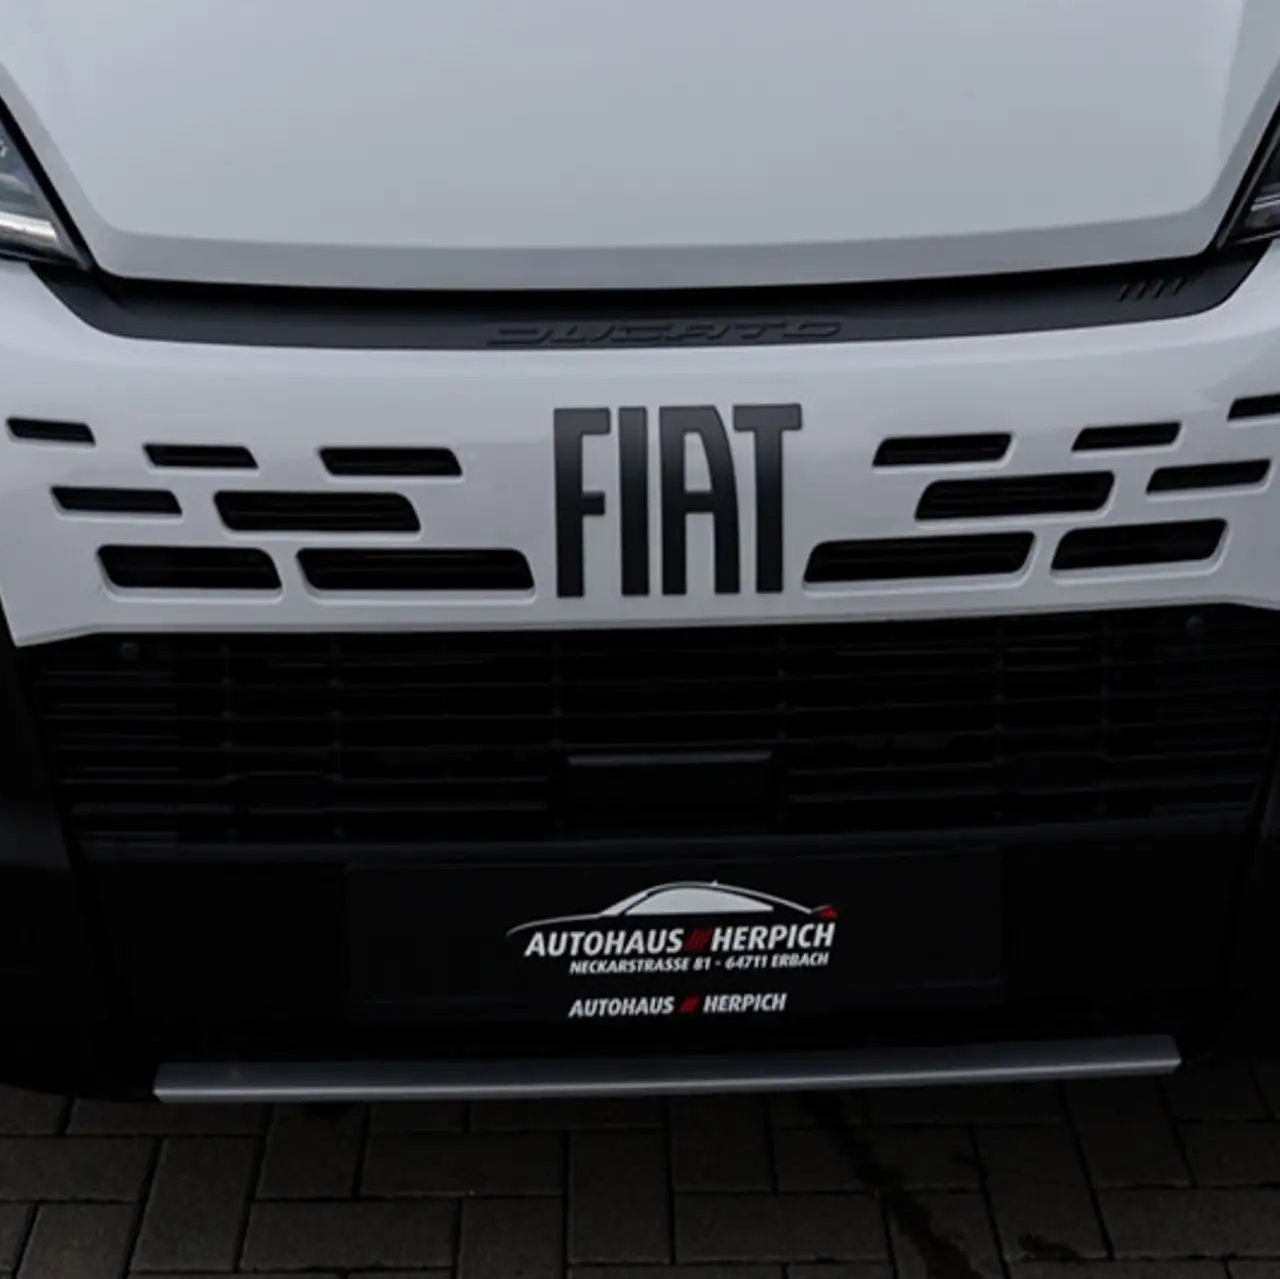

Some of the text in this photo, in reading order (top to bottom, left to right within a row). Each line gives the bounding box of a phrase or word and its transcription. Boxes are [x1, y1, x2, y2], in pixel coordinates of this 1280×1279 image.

[486, 321, 843, 346] DUCATO
[553, 403, 803, 599] FIAT
[524, 922, 836, 957] AUTOHAUS HERPICH
[570, 957, 690, 975] NECKARSTRASSE
[693, 956, 711, 971] 81
[725, 954, 767, 970] 64711
[771, 951, 829, 969] ERBACH
[568, 993, 787, 1018] AUTOHAUS HERPICH
